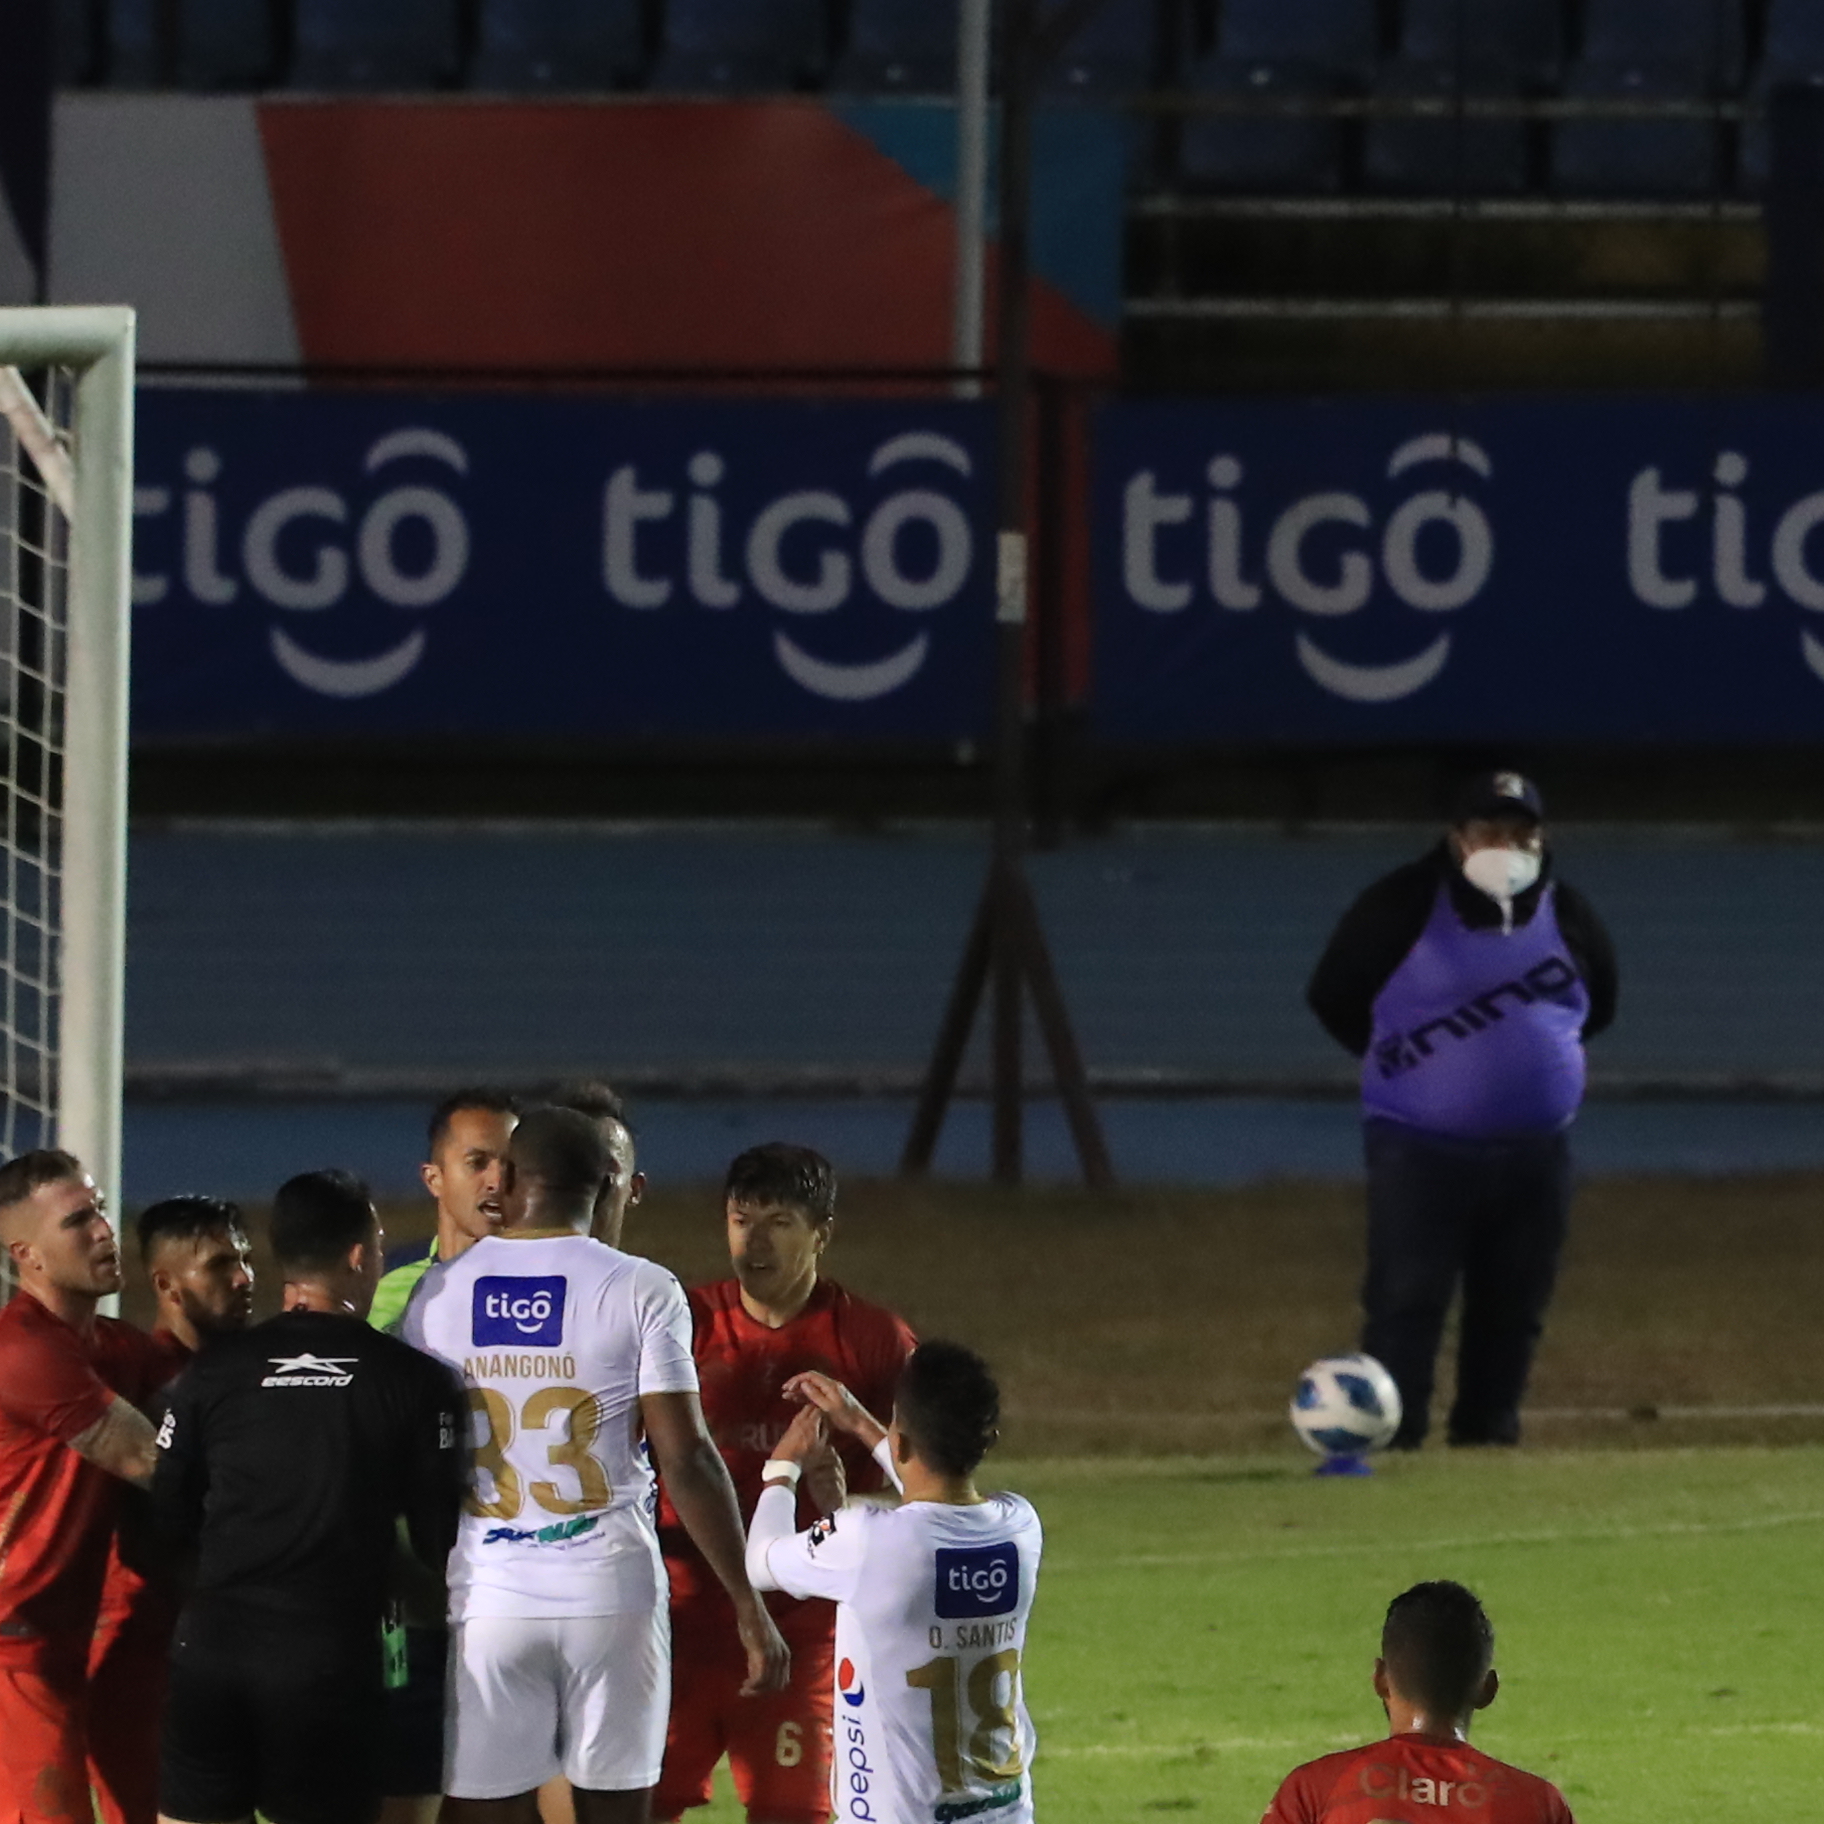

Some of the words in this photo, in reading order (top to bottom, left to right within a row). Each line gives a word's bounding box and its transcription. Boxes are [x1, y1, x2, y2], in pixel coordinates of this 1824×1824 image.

[600, 431, 973, 614] tigo
[1120, 430, 1495, 617] tigo
[485, 1291, 552, 1320] tigo
[947, 1558, 1008, 1592] tigo
[956, 1616, 1018, 1651] SANTIS
[775, 1719, 803, 1769] 6
[841, 1714, 876, 1823] pepsi
[1359, 1761, 1488, 1808] Claro
